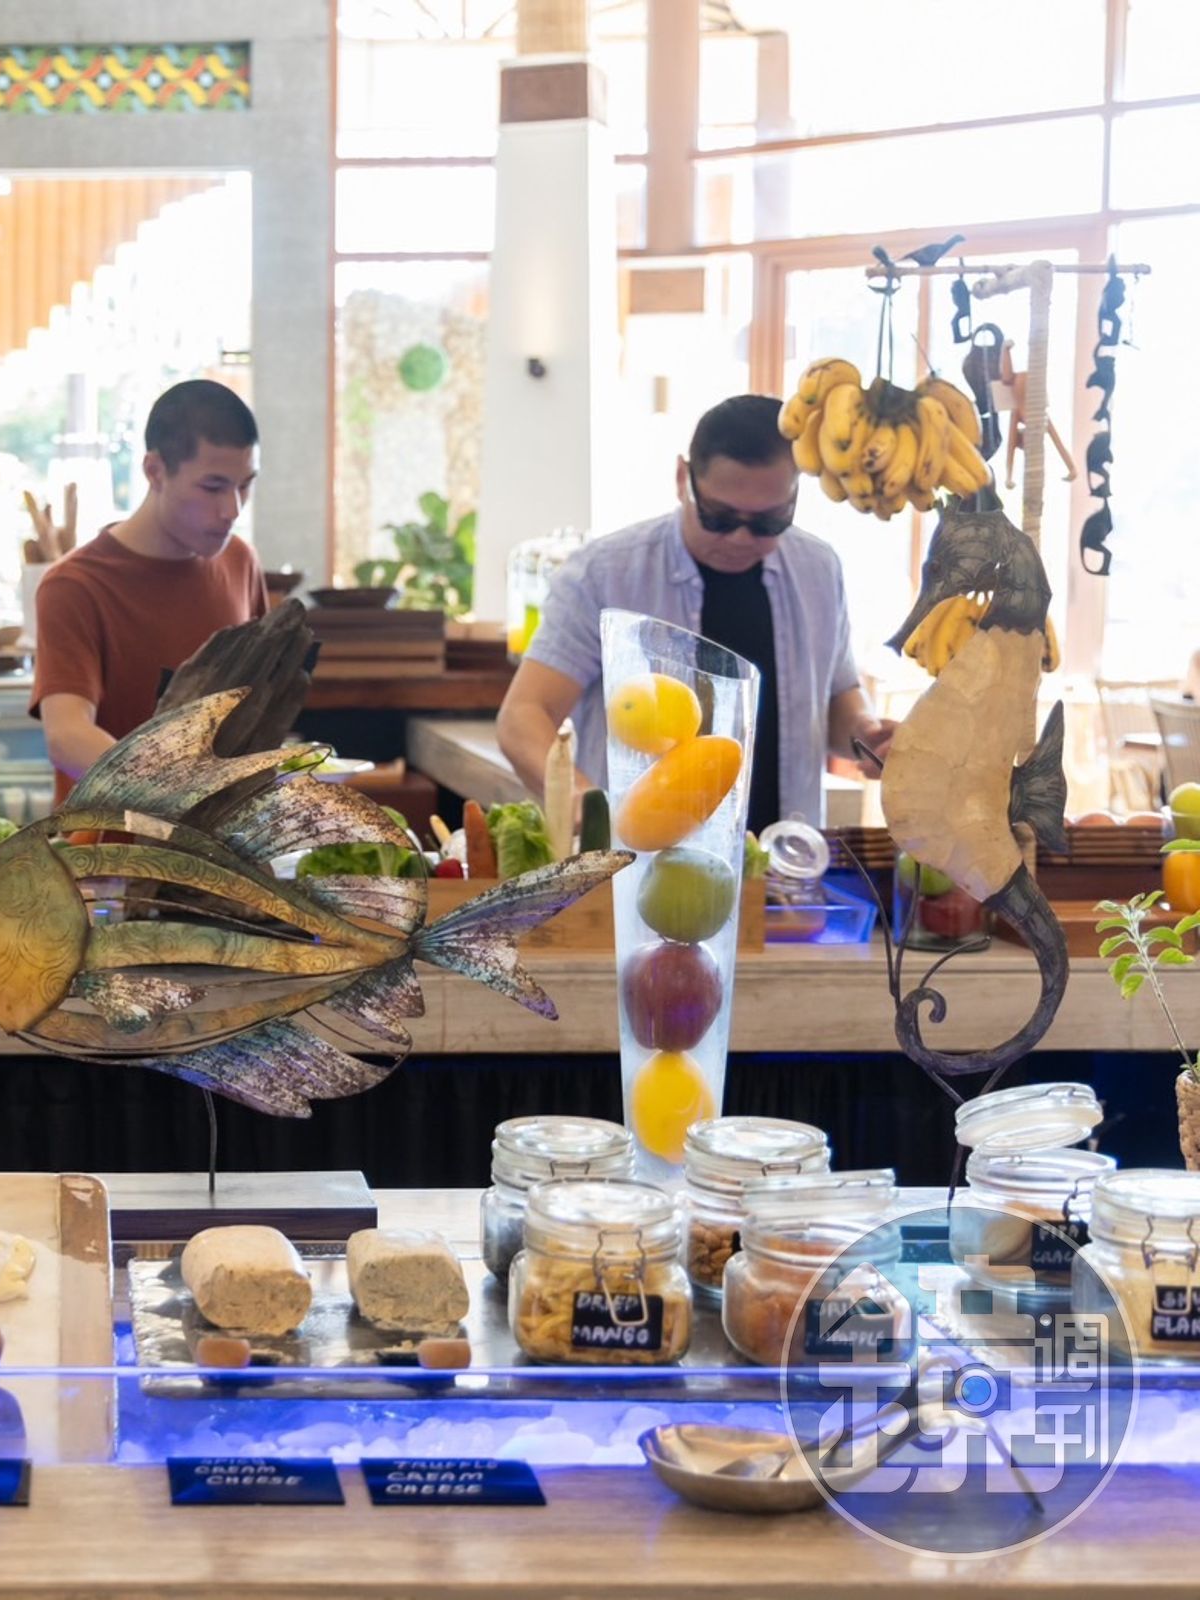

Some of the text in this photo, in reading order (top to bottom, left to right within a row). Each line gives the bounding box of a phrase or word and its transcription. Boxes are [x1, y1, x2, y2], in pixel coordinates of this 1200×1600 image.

[573, 1325, 650, 1345] MANGO
[205, 1475, 303, 1486] CHEESE
[386, 1471, 485, 1482] CREAM
[384, 1483, 483, 1495] CHEESE
